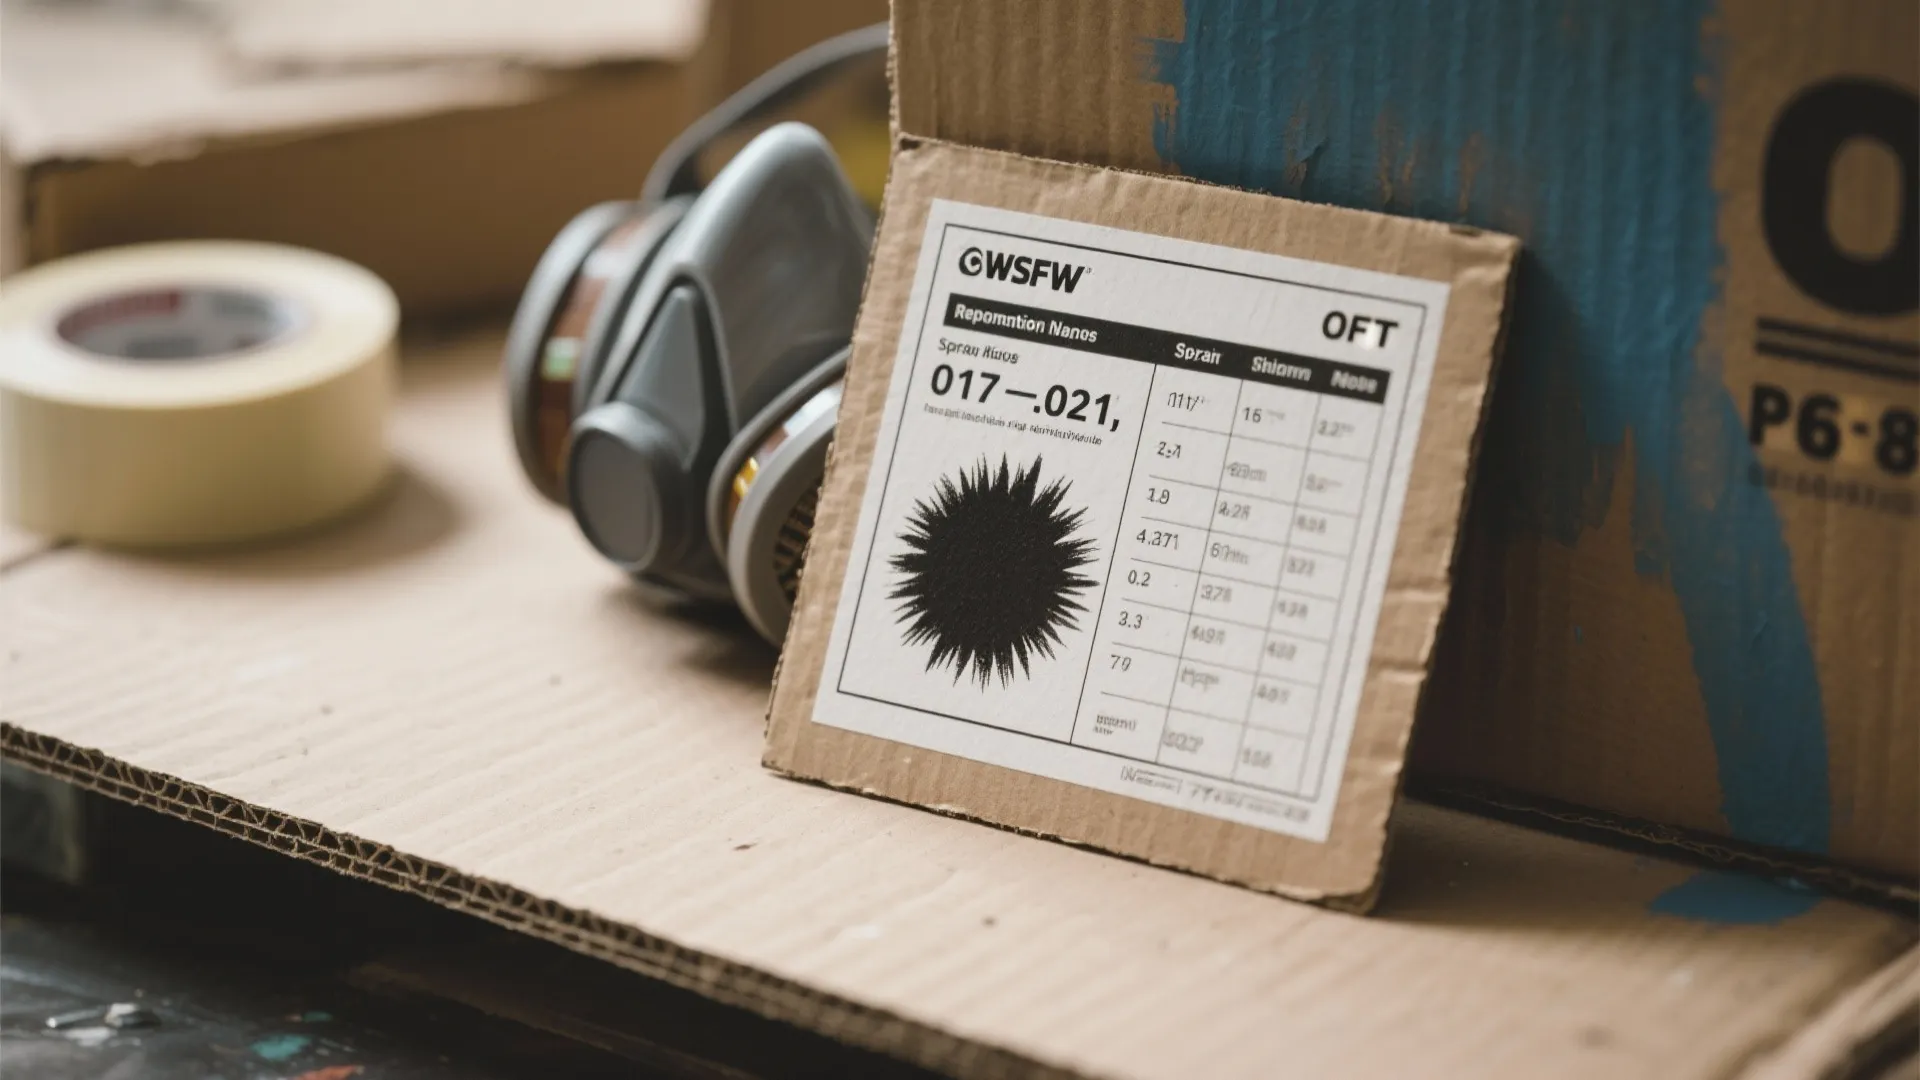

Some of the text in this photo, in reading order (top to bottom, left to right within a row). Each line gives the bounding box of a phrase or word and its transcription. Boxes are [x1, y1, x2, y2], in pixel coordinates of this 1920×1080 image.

[1322, 310, 1399, 348] OFT
[1127, 569, 1151, 587] 0.2
[1118, 611, 1143, 629] 3.3
